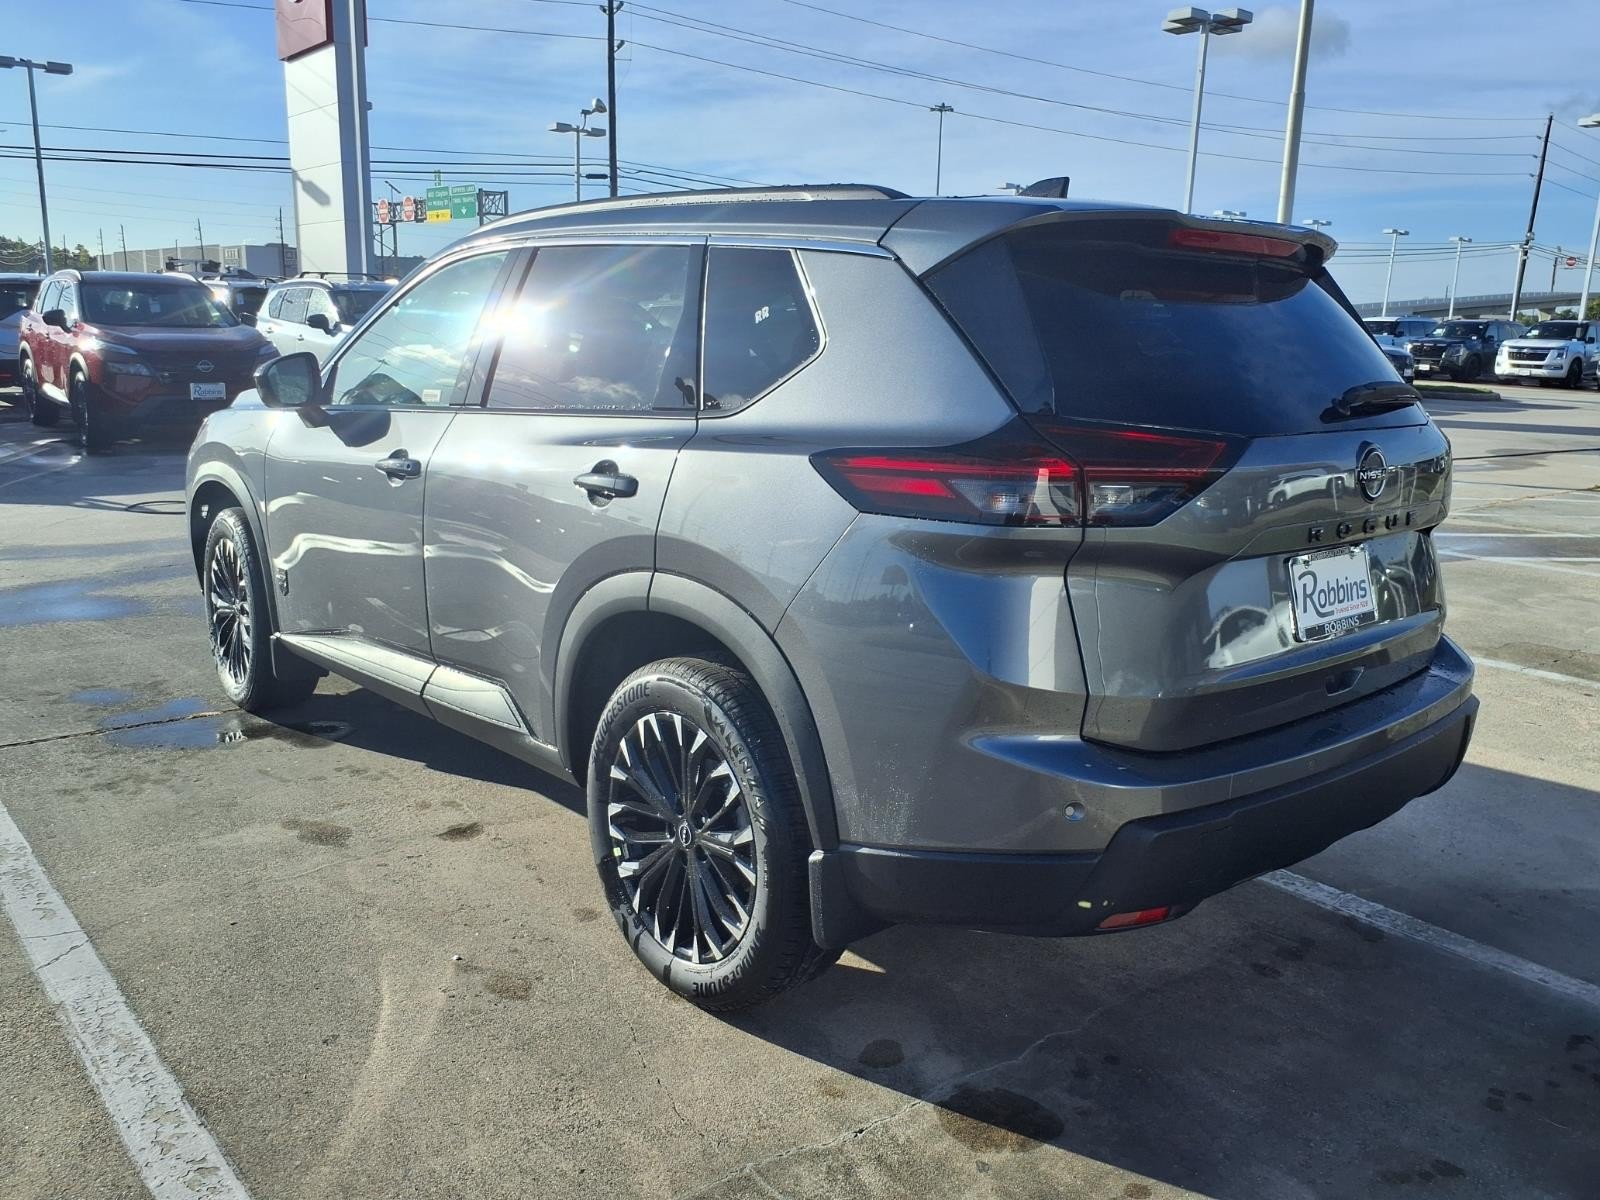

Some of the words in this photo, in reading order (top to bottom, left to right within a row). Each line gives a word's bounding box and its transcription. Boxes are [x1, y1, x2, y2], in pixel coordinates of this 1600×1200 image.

[193, 385, 222, 397] Robbins
[1308, 510, 1419, 543] ROGUE
[1298, 570, 1368, 618] Robbins
[1324, 616, 1360, 634] ROBBINS
[591, 680, 651, 764] BRIDGESTONE
